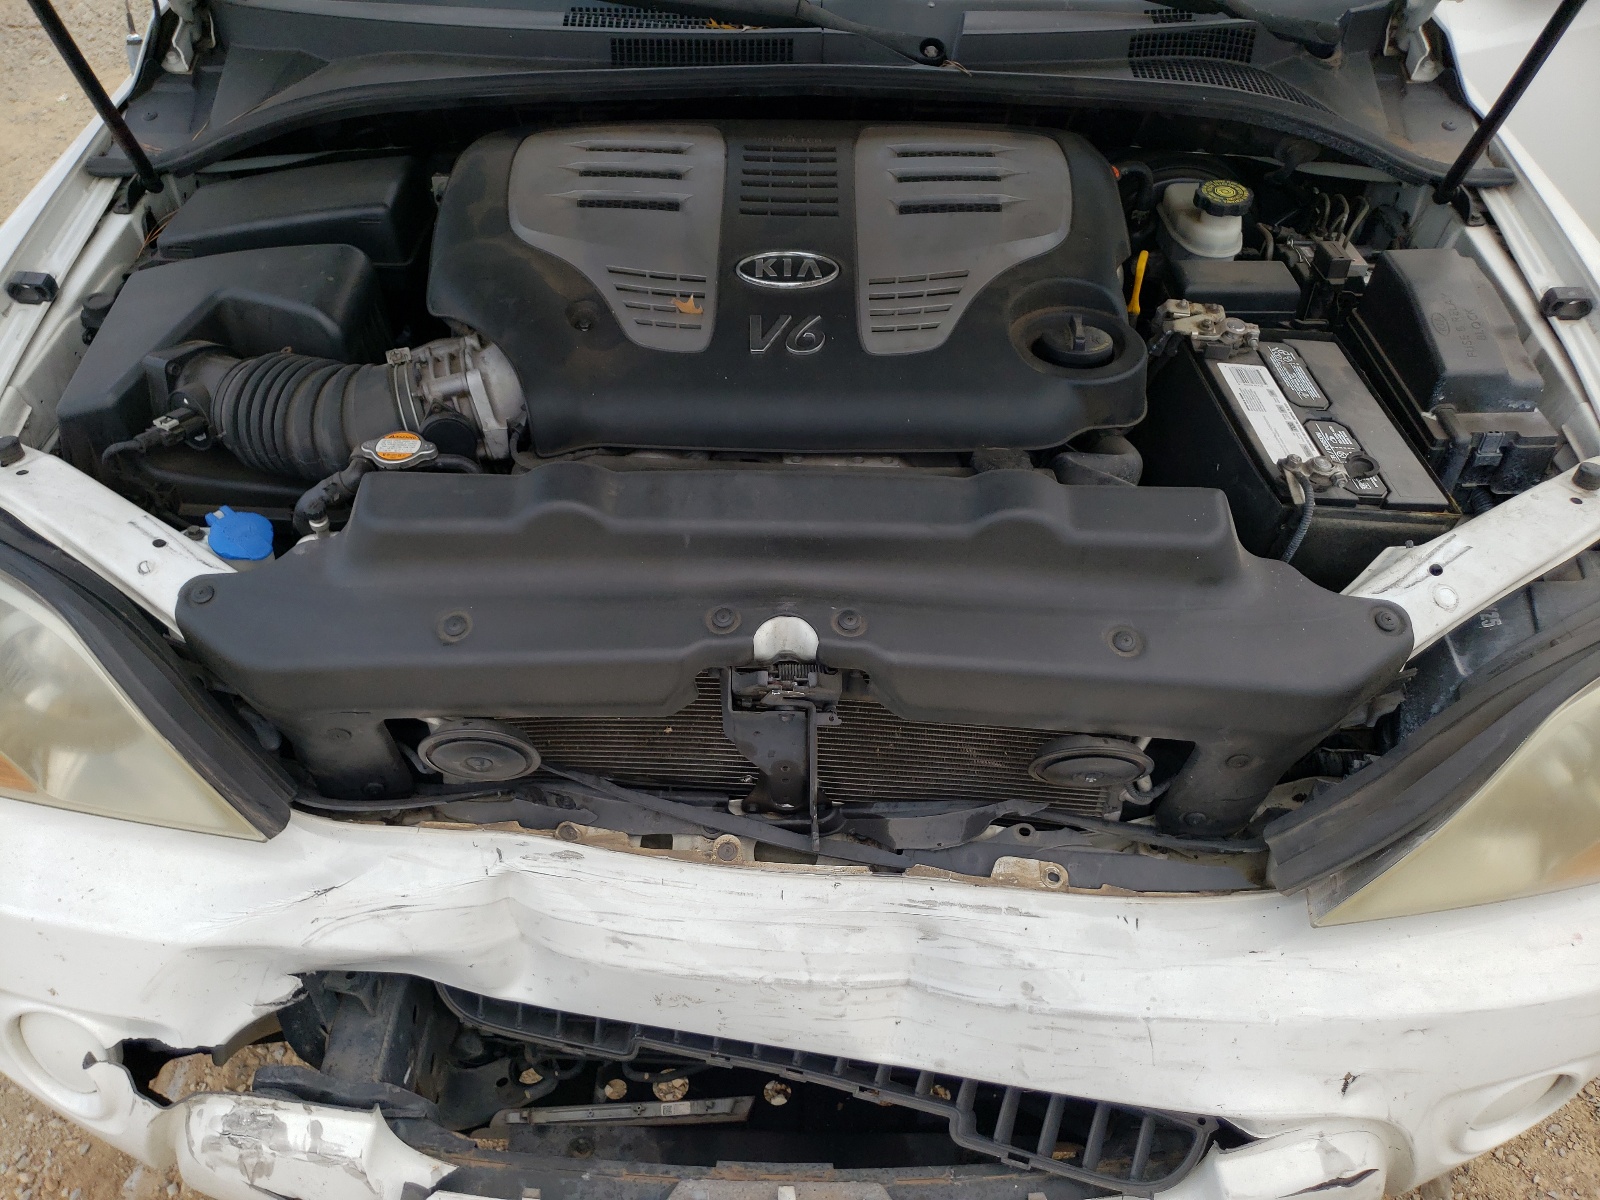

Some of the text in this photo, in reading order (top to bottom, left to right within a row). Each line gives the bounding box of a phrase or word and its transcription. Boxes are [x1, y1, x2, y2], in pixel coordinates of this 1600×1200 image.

[754, 258, 823, 278] KIA
[749, 314, 826, 356] V6
[1464, 308, 1487, 341] BLOCK
[1459, 334, 1477, 358] FUSE
